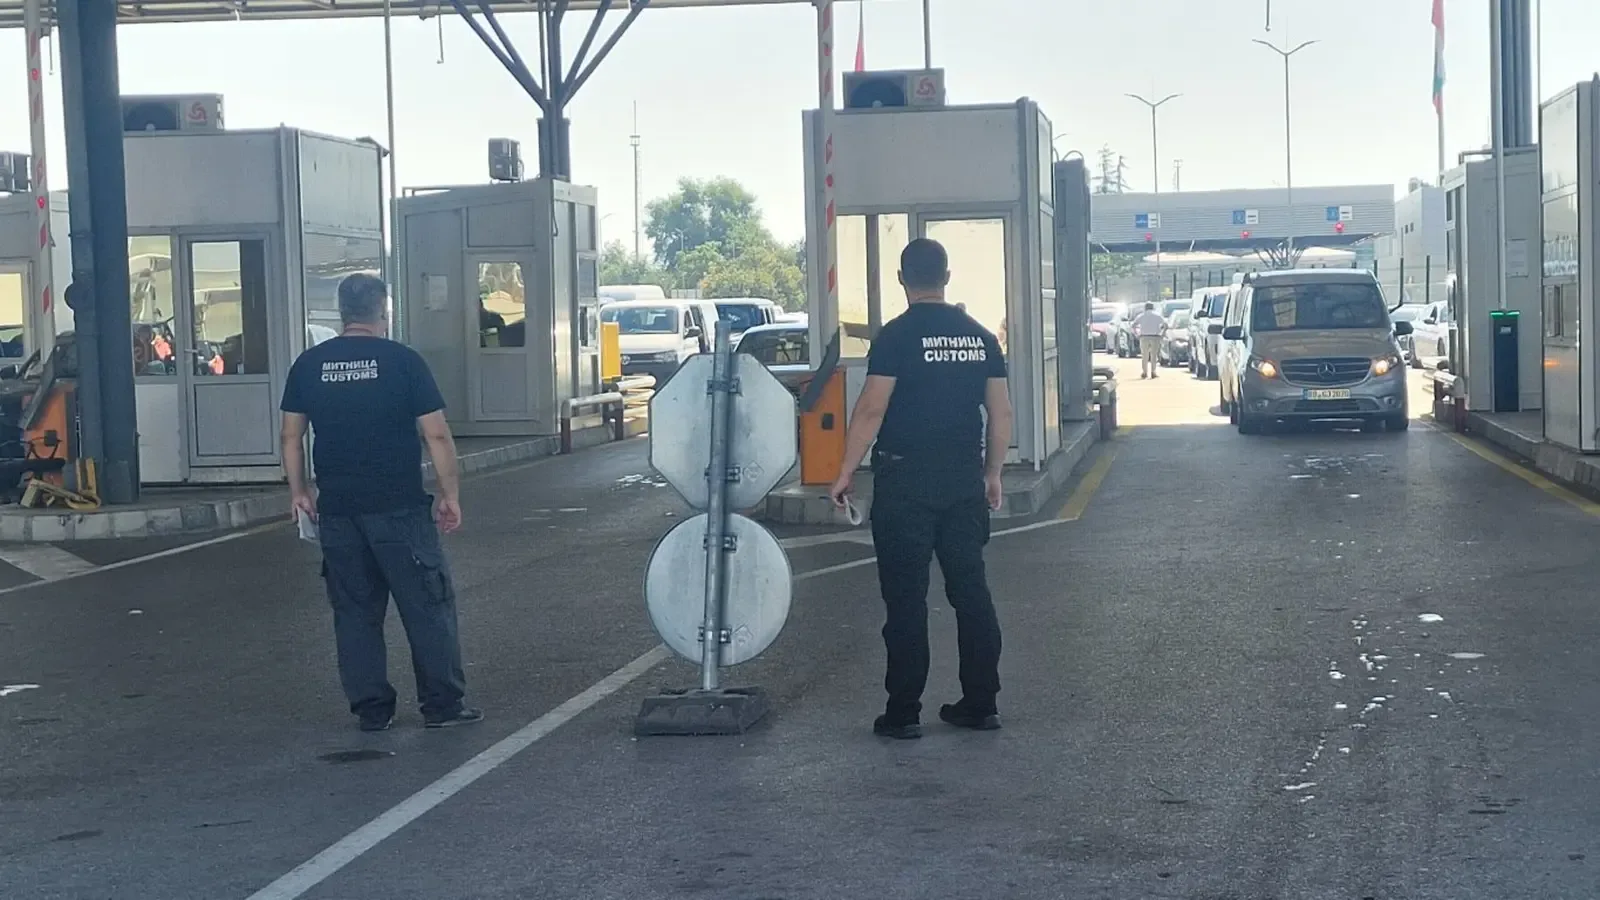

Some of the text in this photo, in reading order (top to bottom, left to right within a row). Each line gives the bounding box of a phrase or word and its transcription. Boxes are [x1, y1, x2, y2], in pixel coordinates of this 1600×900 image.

[921, 336, 985, 348] МИТНИЦА
[923, 349, 986, 362] CUSTOMS
[322, 359, 378, 371] МИТНИЦА
[321, 369, 378, 382] CUSTOMS
